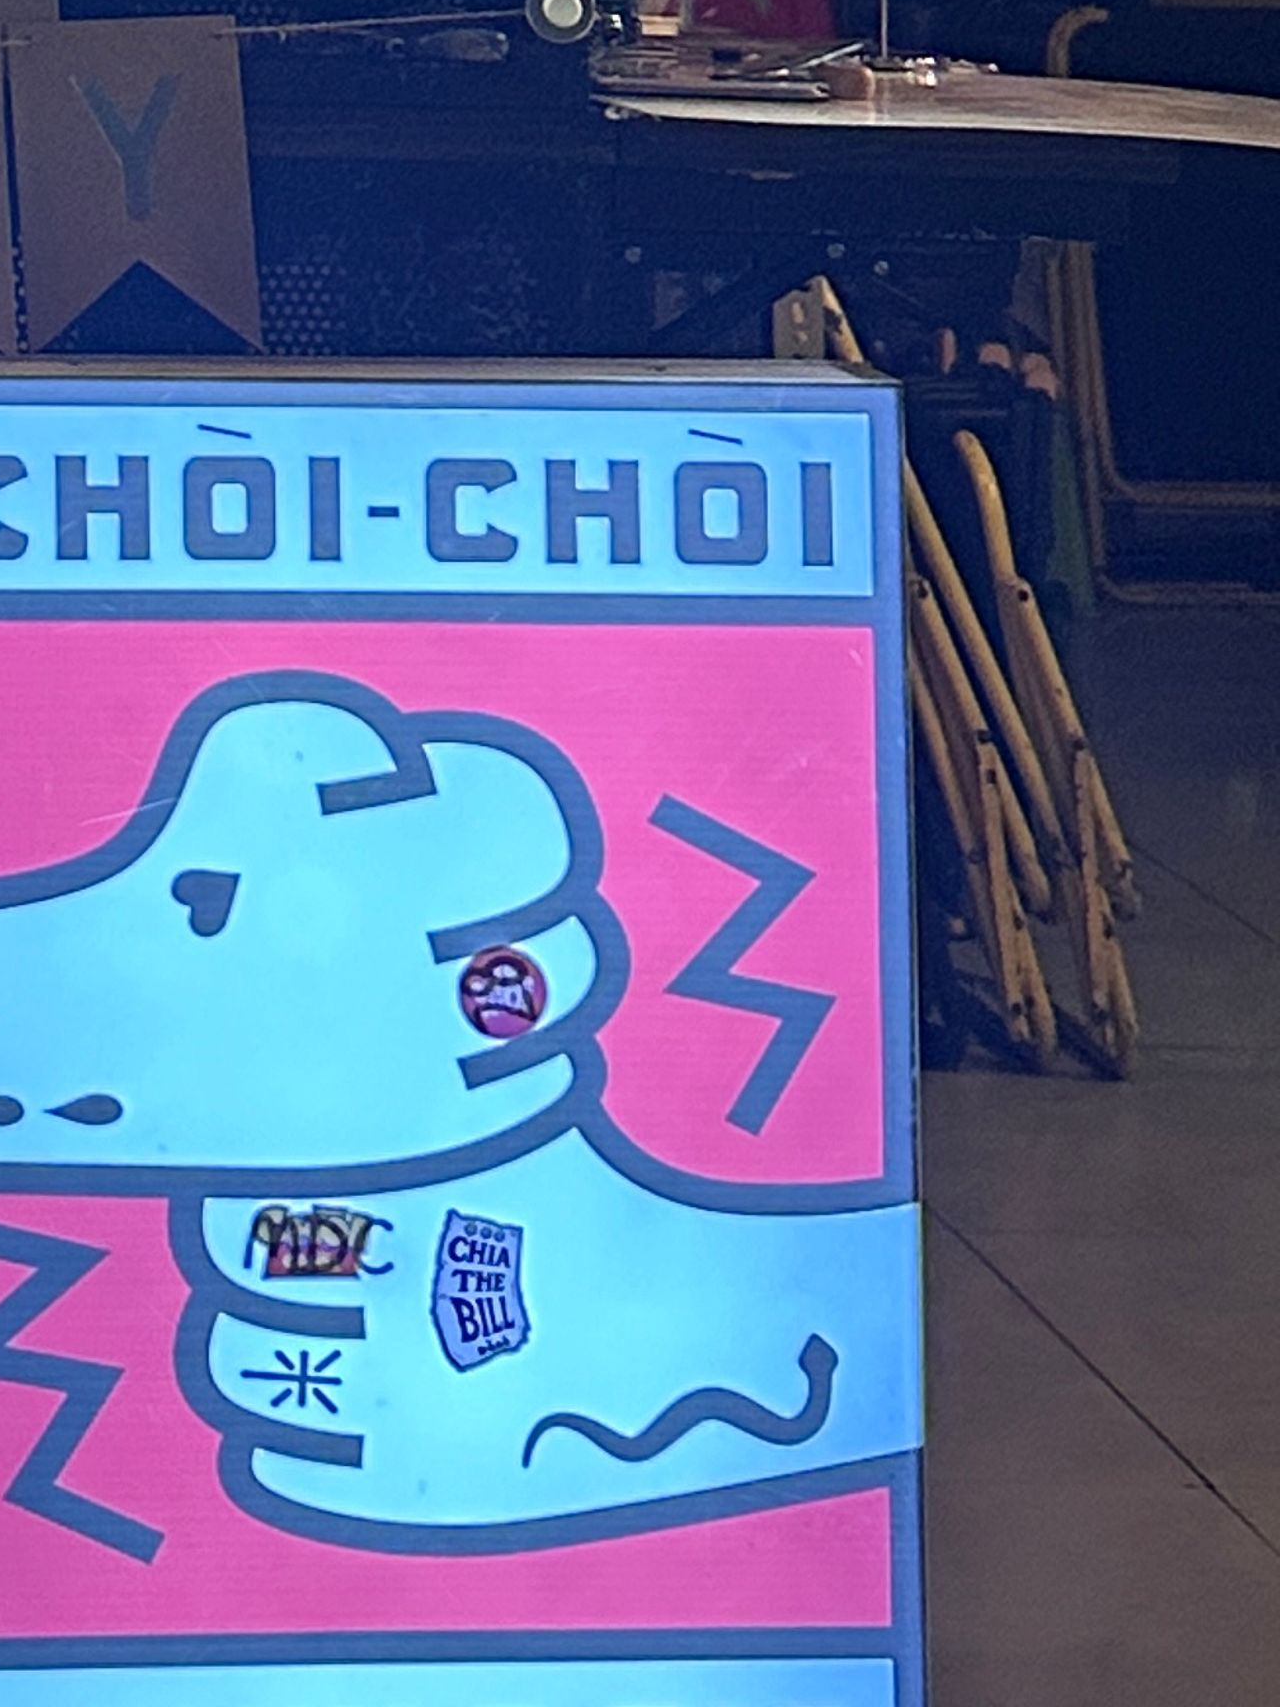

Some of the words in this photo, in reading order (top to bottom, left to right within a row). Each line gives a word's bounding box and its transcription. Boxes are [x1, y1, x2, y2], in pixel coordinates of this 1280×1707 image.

[447, 1235, 511, 1269] CHIA
[451, 1268, 506, 1293] THE
[449, 1295, 516, 1344] BILL
